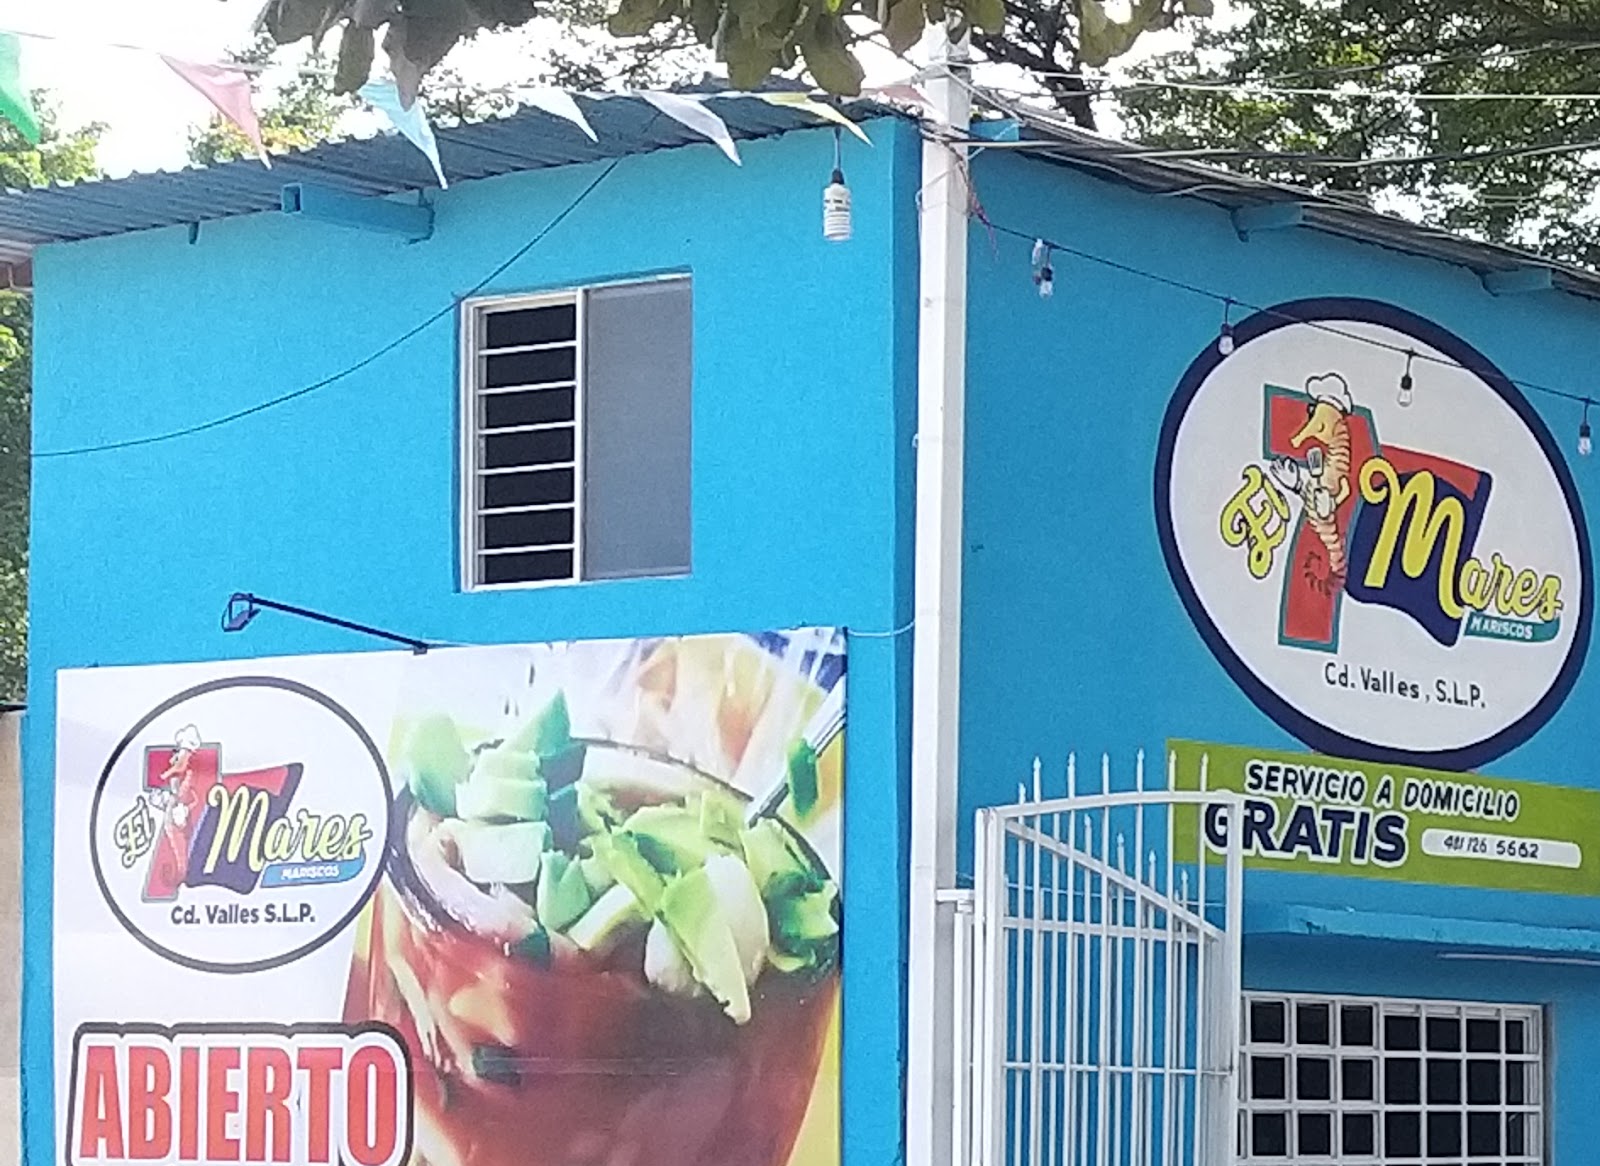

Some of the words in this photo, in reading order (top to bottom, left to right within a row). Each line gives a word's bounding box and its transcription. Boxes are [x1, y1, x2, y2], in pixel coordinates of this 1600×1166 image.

[1220, 464, 1291, 579] El
[1359, 456, 1564, 620] Mares
[1470, 616, 1534, 640] MARISCOS
[1325, 662, 1355, 688] Cd.
[1436, 679, 1487, 708] S.L.P.
[1246, 763, 1366, 801] SERVICIO
[1376, 776, 1392, 804] A
[1404, 780, 1518, 818] DOMICILIO
[114, 796, 155, 868] El
[207, 783, 373, 873] Mares
[1205, 800, 1408, 862] GRATIS
[1467, 836, 1488, 853] 126
[1495, 840, 1540, 859] 5662
[281, 862, 340, 880] MARISCOS
[170, 904, 201, 924] Cd.
[206, 903, 259, 924] Valles
[263, 902, 316, 923] S.L.P.
[79, 1045, 398, 1166] ABIERTO
